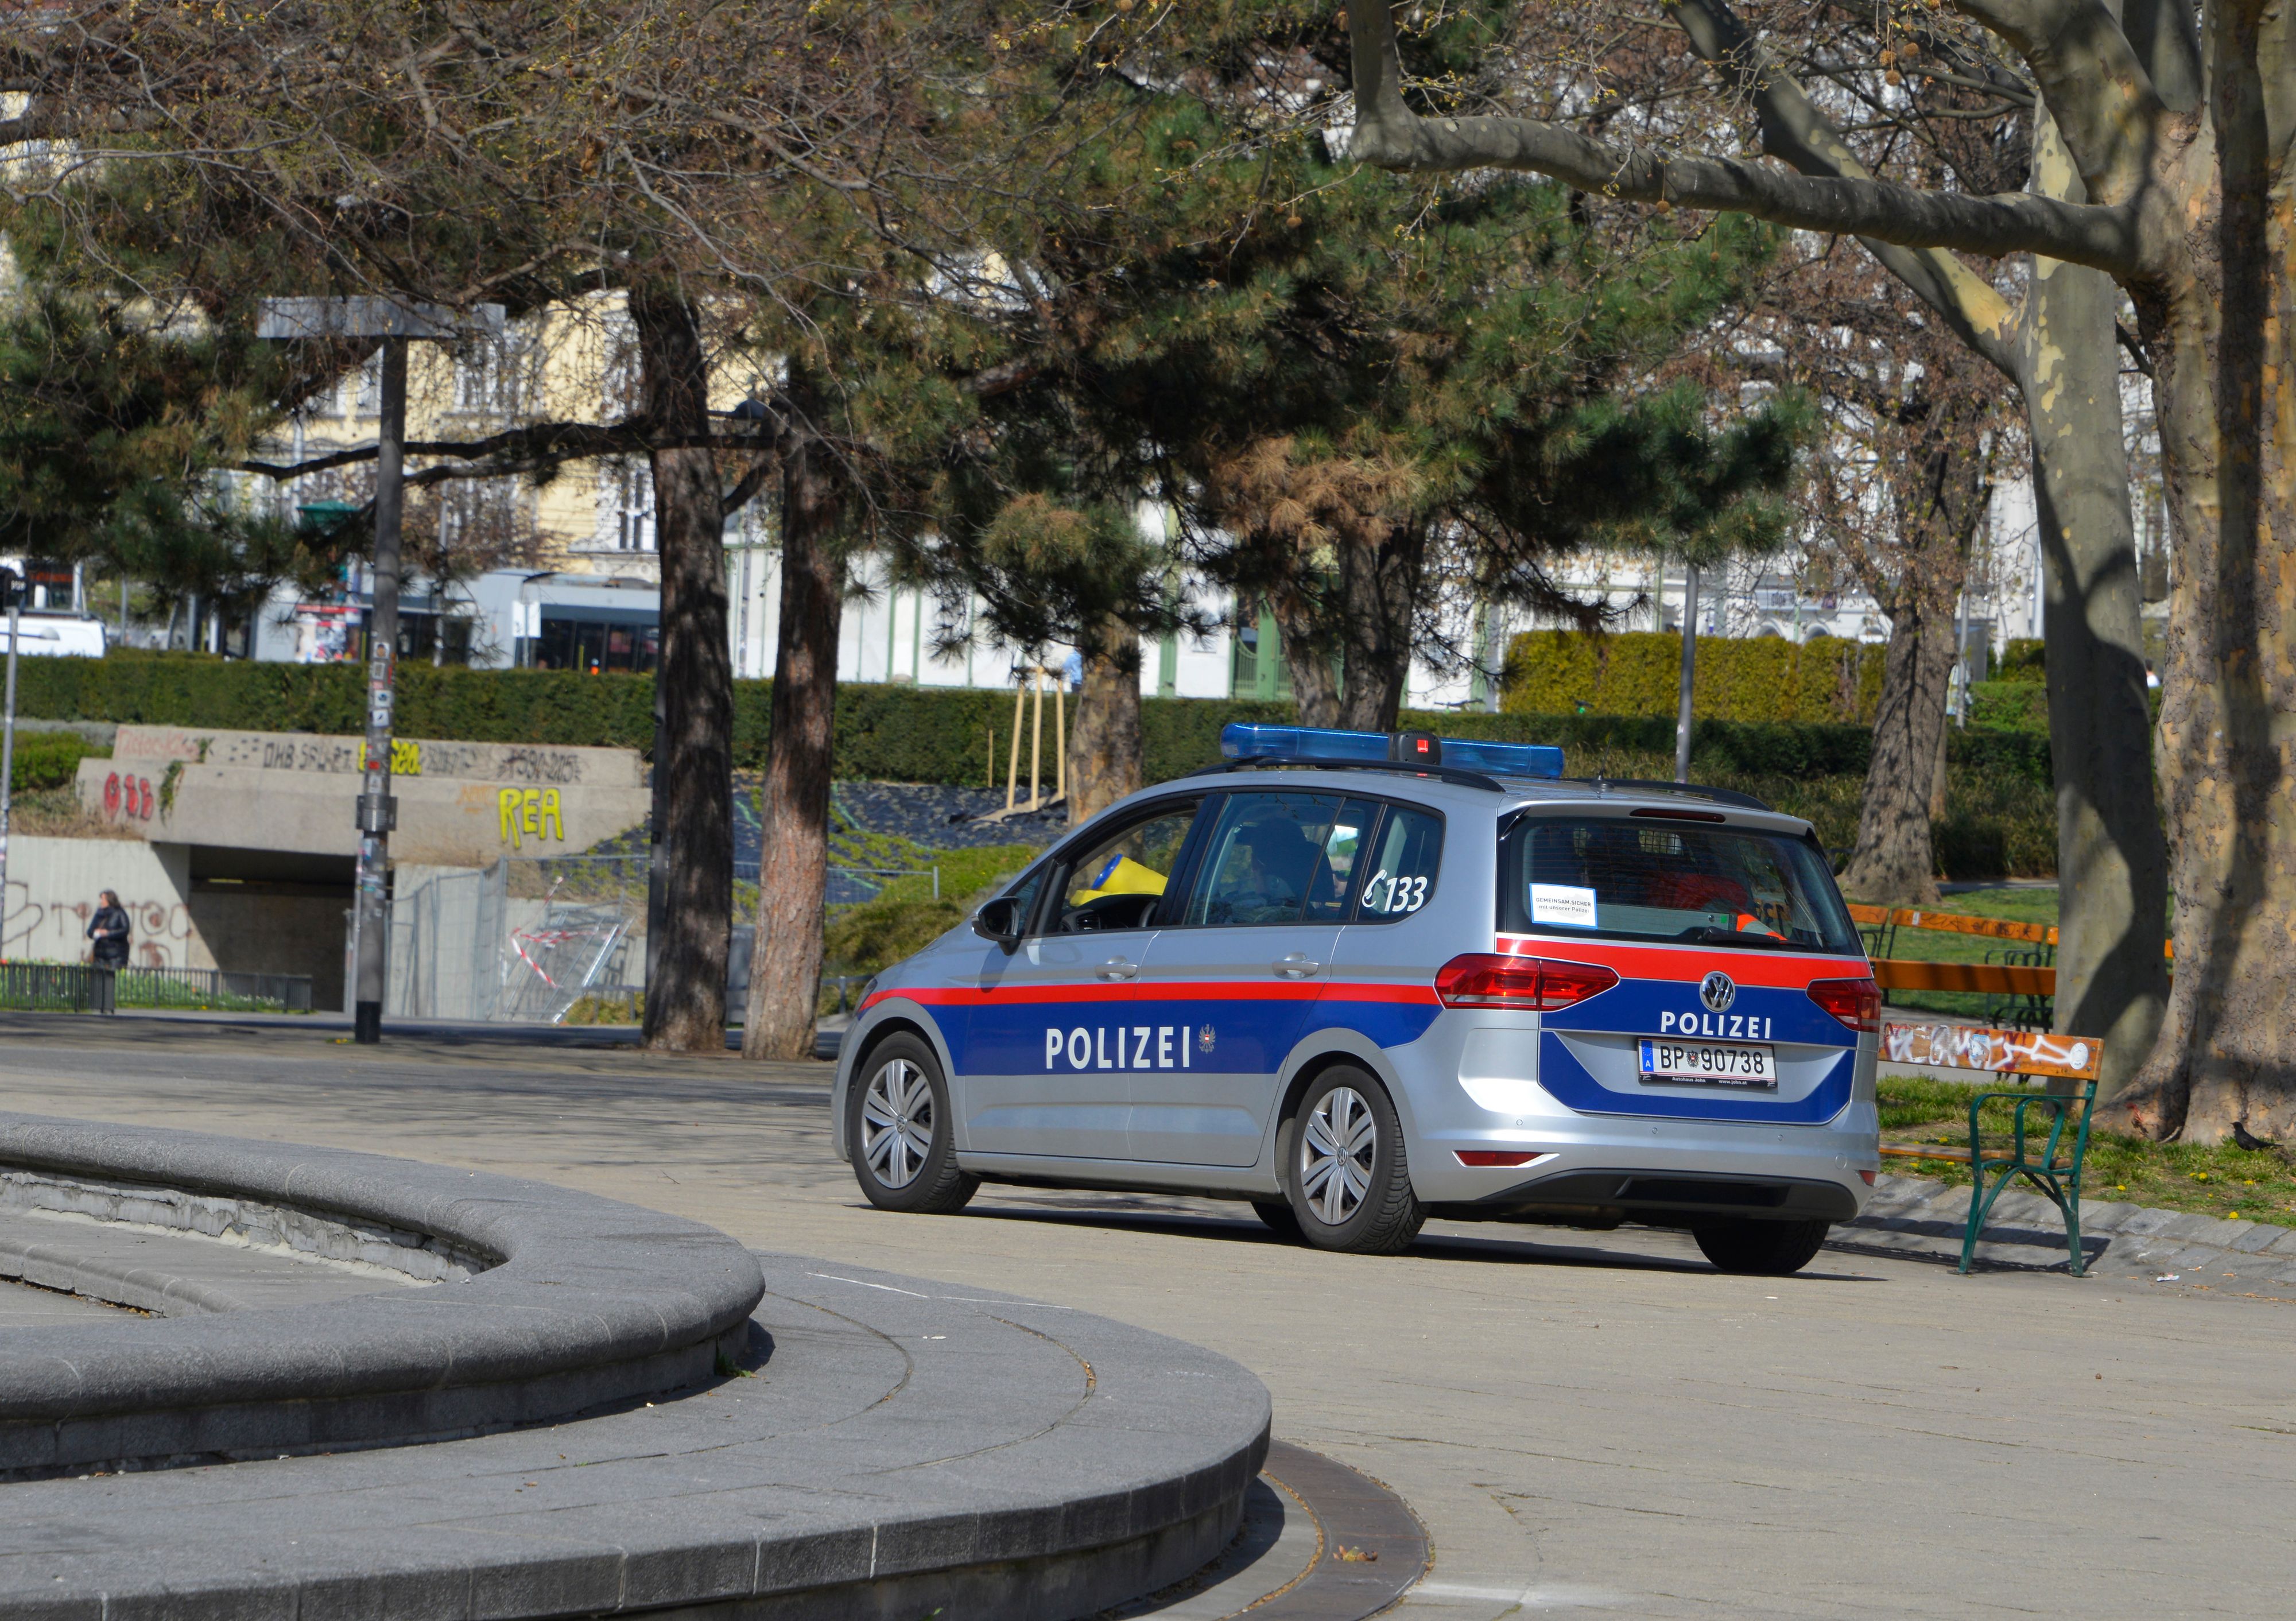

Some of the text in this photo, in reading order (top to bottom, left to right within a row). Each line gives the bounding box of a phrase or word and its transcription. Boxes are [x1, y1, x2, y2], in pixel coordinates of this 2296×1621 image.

[499, 788, 564, 850] REA
[1384, 877, 1428, 912] 133
[1536, 898, 1591, 907] GEMEINSAM.SICHER
[1661, 1011, 1771, 1039] POLIZEI
[1046, 1026, 1190, 1069] POLIZEI
[1660, 1046, 1764, 1075] BP 90738
